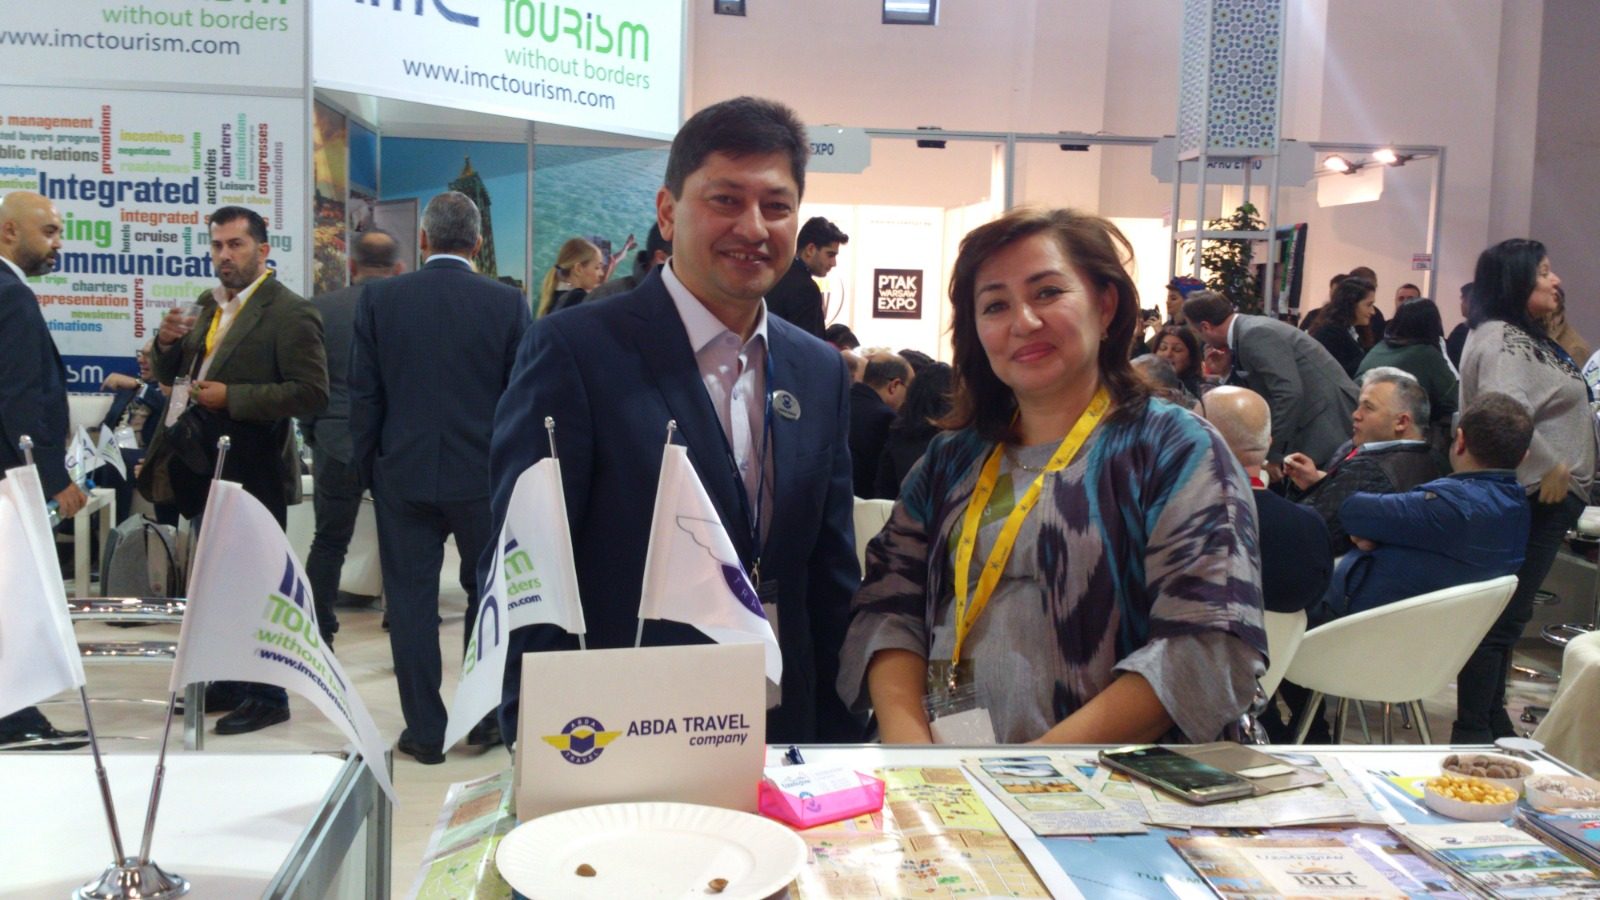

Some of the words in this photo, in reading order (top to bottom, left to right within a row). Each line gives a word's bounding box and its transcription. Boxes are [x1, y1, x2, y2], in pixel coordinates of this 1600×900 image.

[103, 6, 193, 28] without
[201, 9, 289, 32] borders
[505, 46, 578, 77] without
[584, 58, 650, 89] borders
[402, 58, 616, 110] www.imctourism.com
[8, 115, 94, 130] management
[99, 104, 114, 174] promotions
[120, 128, 185, 144] incentives
[31, 146, 99, 162] relations
[219, 123, 231, 177] charters
[258, 123, 271, 194] congresses
[204, 148, 216, 205] activities
[220, 181, 256, 191] Leisure
[39, 172, 199, 208] Integrated
[120, 208, 198, 227] integrated
[62, 212, 111, 248] ing
[134, 230, 178, 243] cruise
[72, 280, 128, 293] charters
[878, 274, 917, 290] PTAK
[878, 297, 917, 310] EXPO
[879, 289, 917, 298] WARSAW
[133, 278, 145, 338] operators
[626, 718, 677, 737] ABDA
[683, 713, 750, 733] TRAVEL
[689, 732, 748, 747] company
